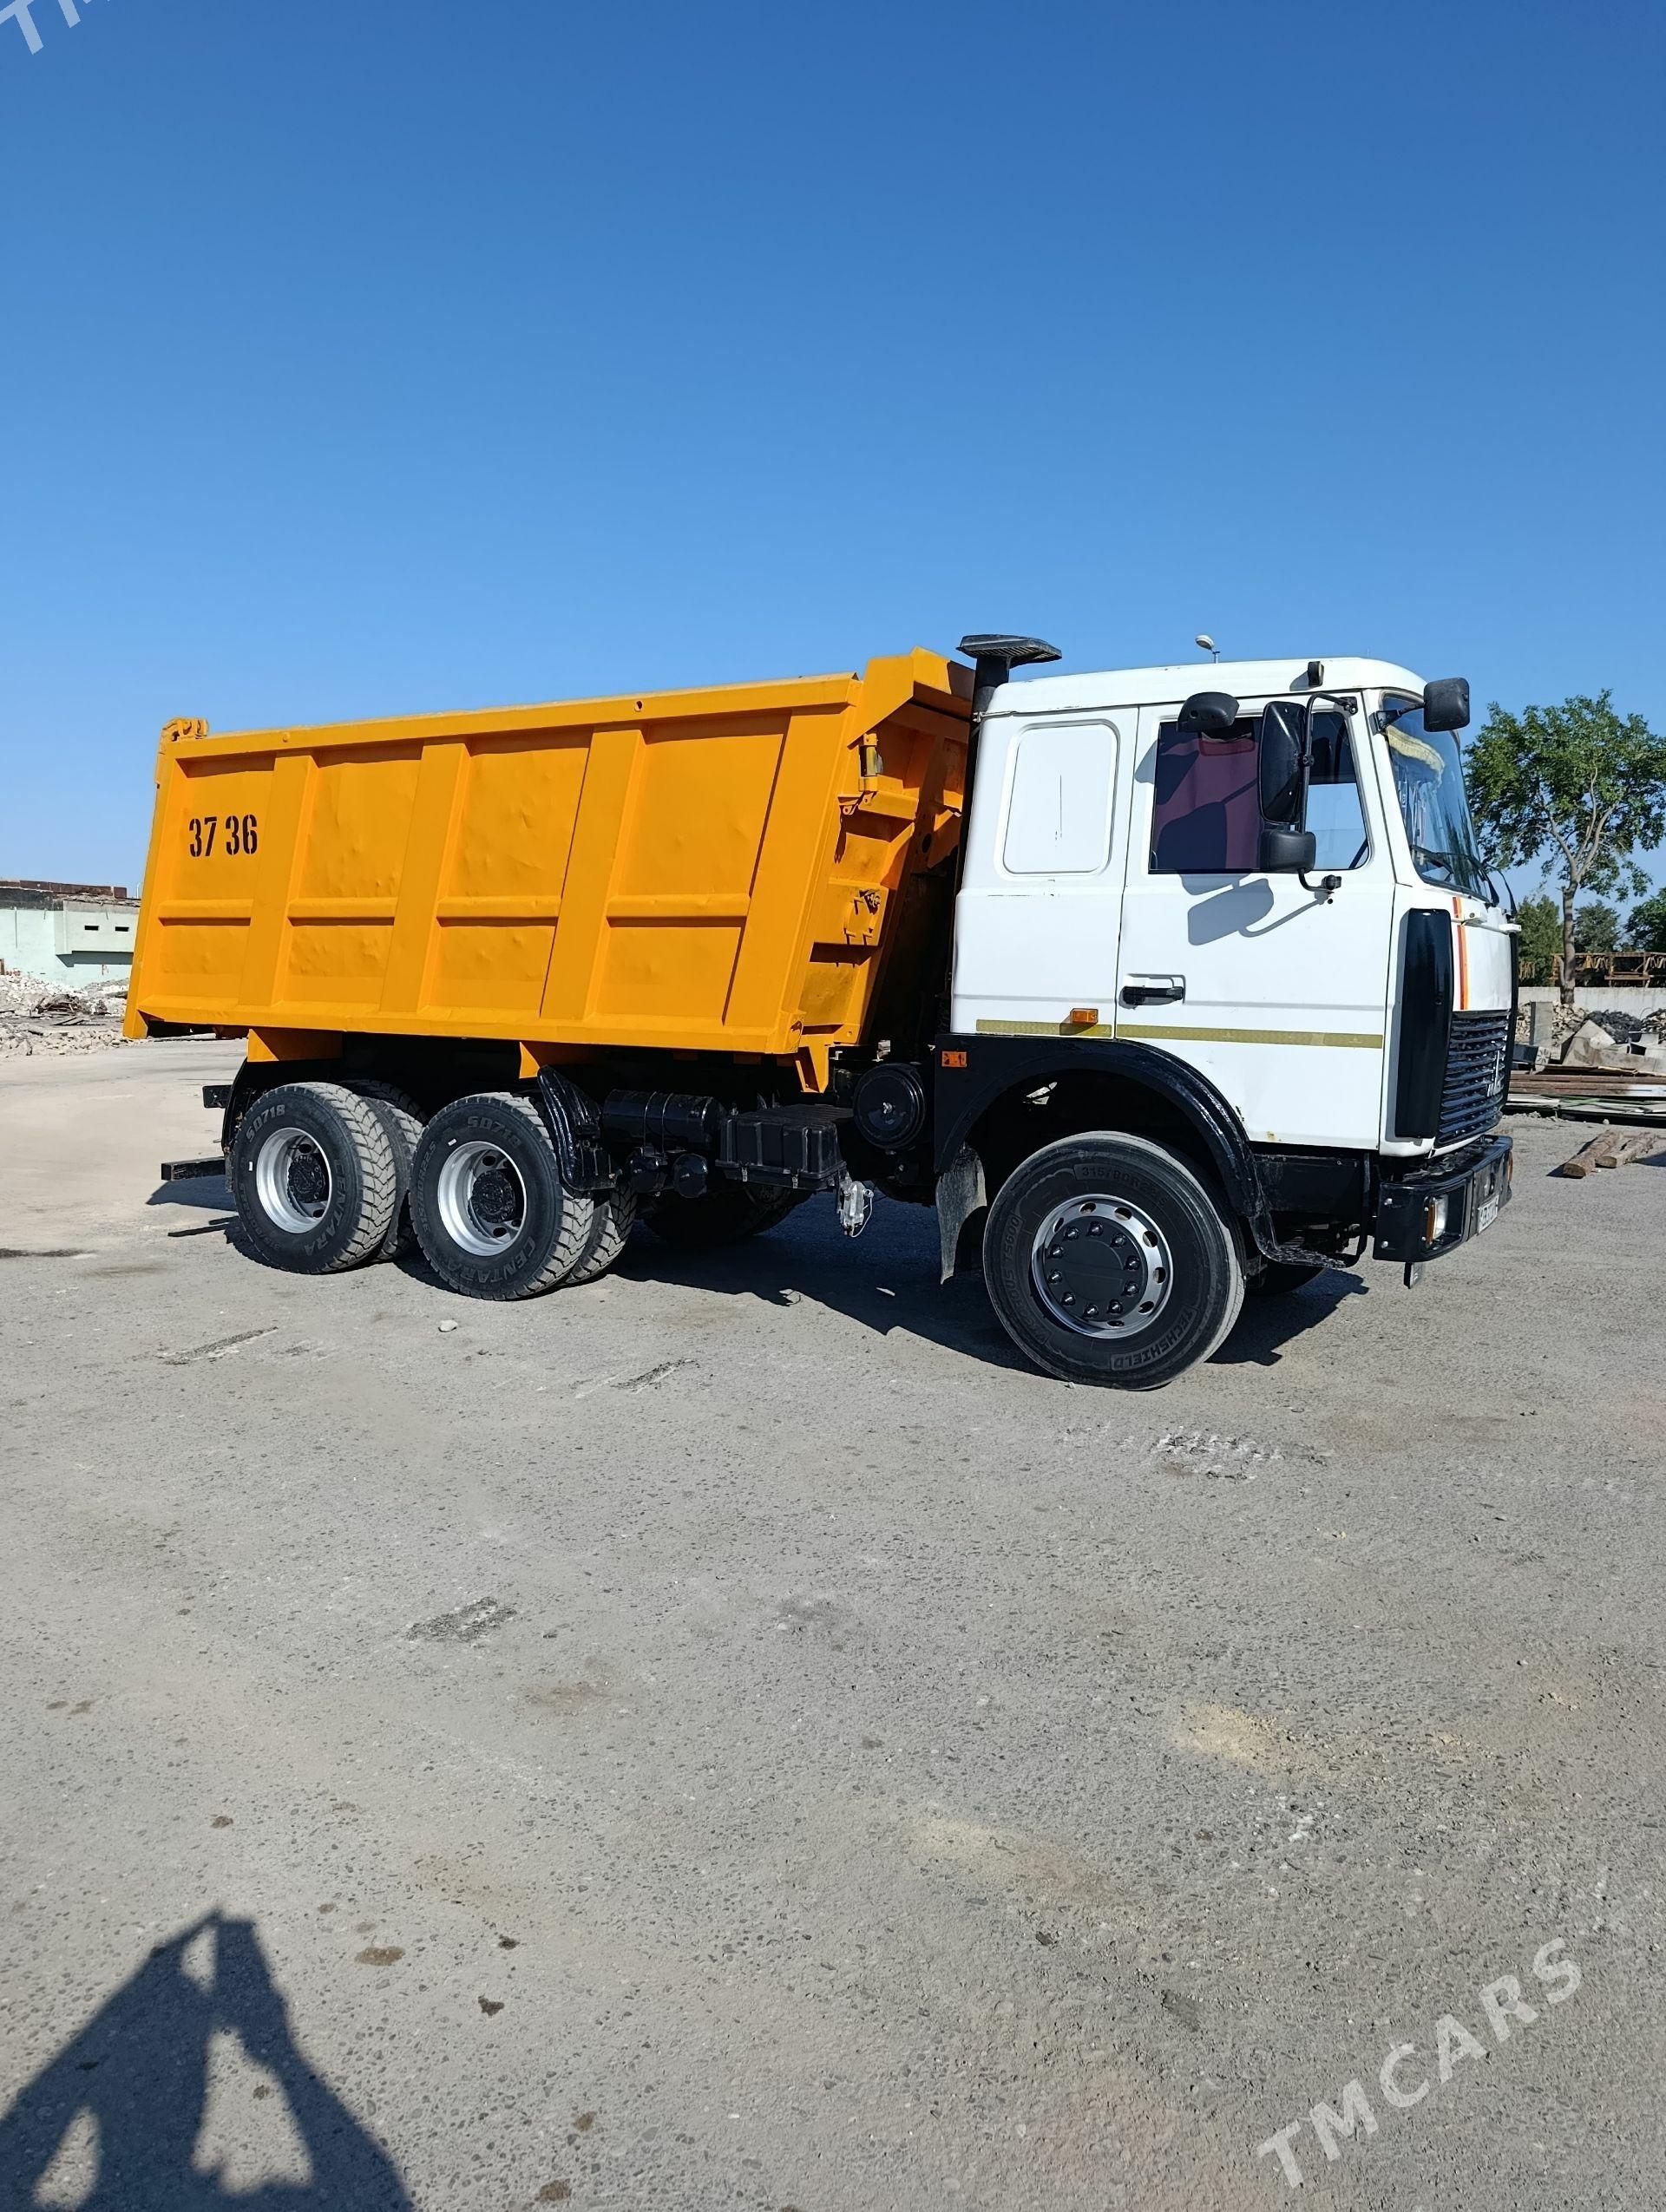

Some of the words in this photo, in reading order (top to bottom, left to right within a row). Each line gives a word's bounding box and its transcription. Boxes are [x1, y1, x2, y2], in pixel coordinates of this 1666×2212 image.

[189, 816, 217, 857] 37
[226, 815, 257, 855] 36
[304, 1159, 346, 1256] CENTARA
[1114, 1307, 1195, 1368] TECHSHIELD
